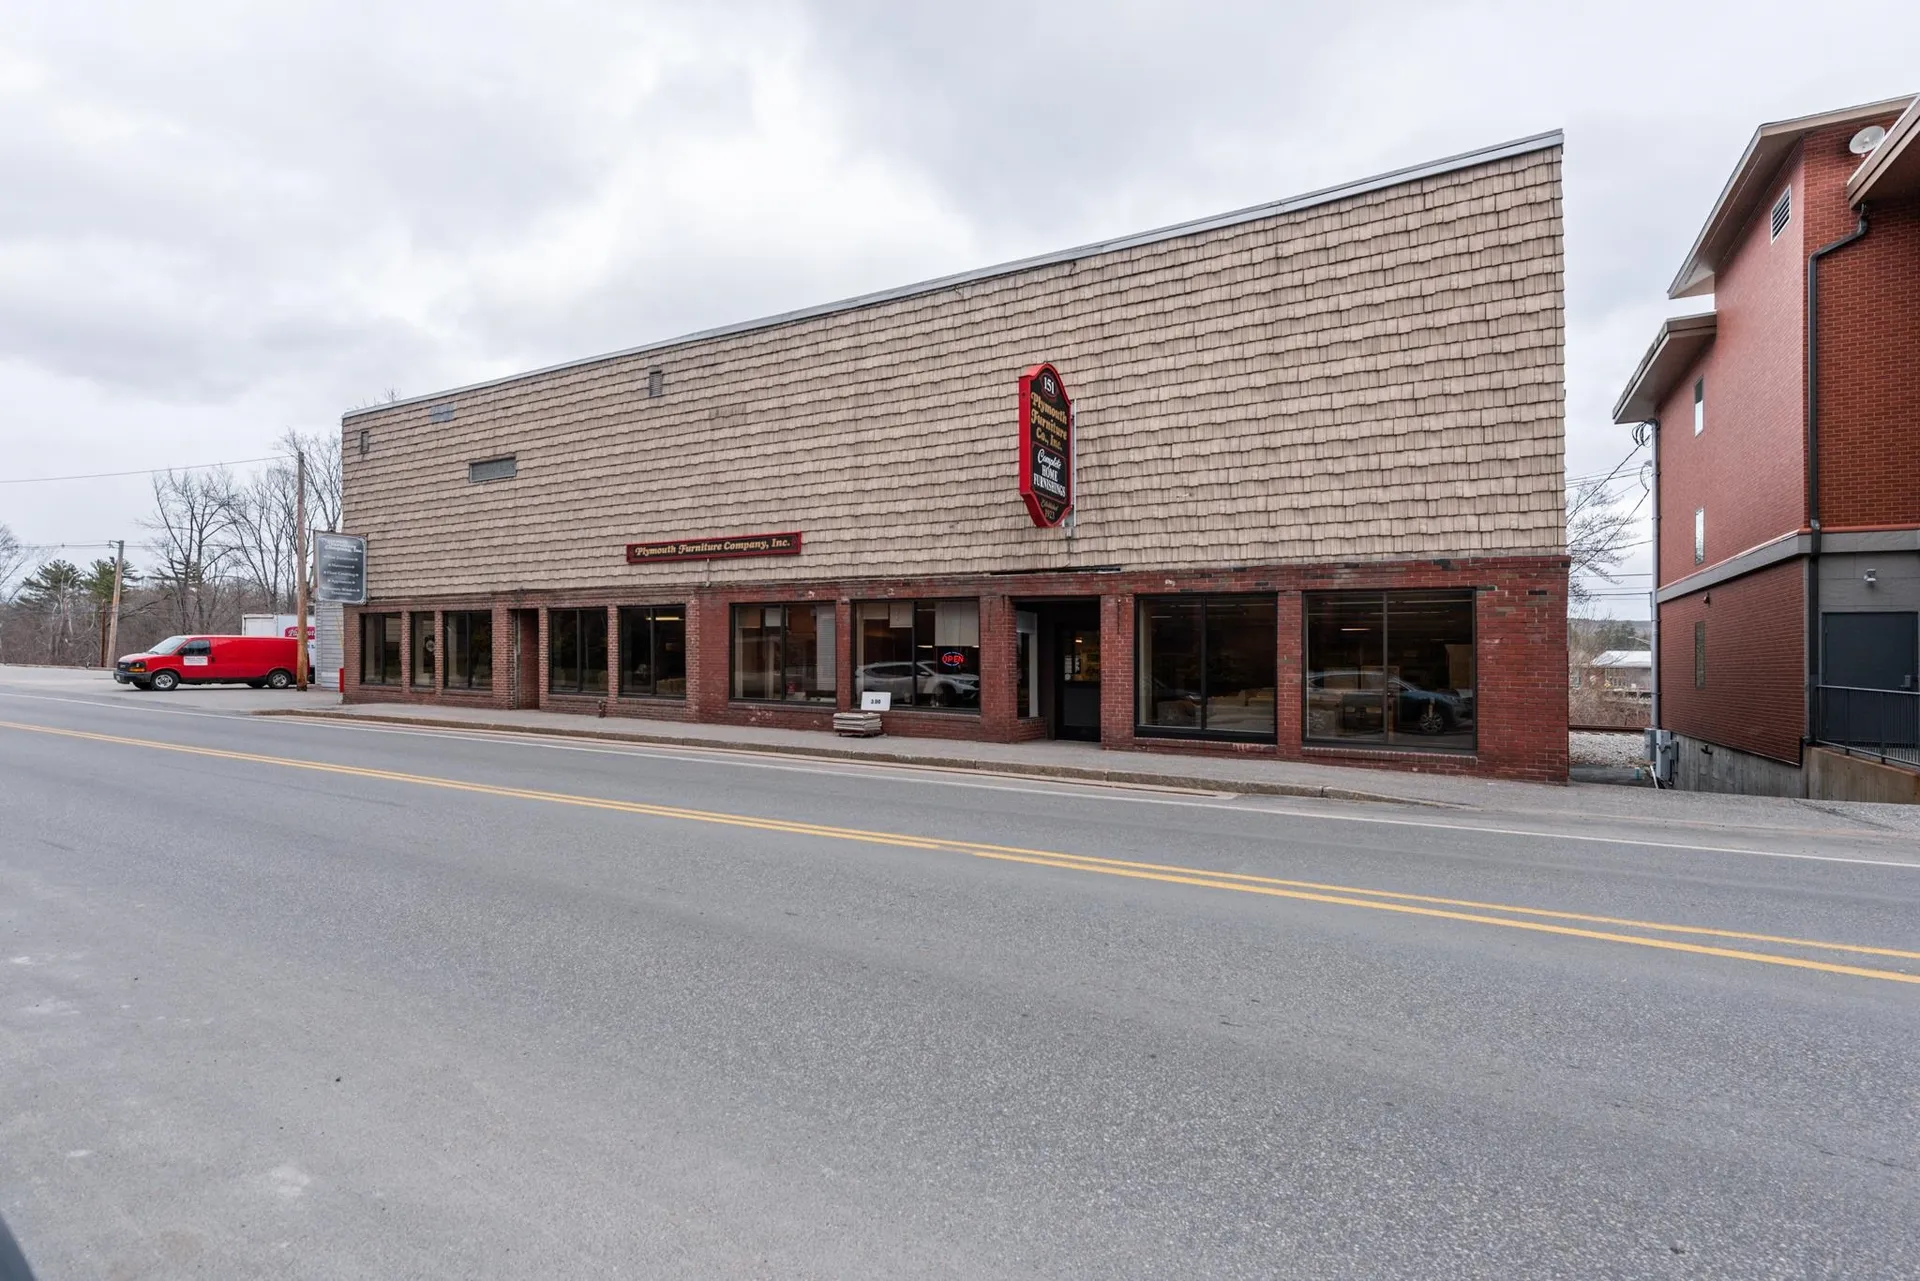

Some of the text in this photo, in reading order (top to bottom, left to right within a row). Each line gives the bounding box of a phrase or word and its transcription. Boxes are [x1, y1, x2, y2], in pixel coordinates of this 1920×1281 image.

[1044, 376, 1055, 395] 151
[1031, 392, 1067, 424] Plymouth
[1031, 408, 1067, 440] Furniture
[1037, 448, 1061, 469] Complete
[1041, 464, 1058, 482] HOME
[1033, 473, 1065, 497] FURNISHINGS
[635, 538, 791, 557] Plymouth Furniture Company, Inc.
[942, 655, 963, 663] OPEN
